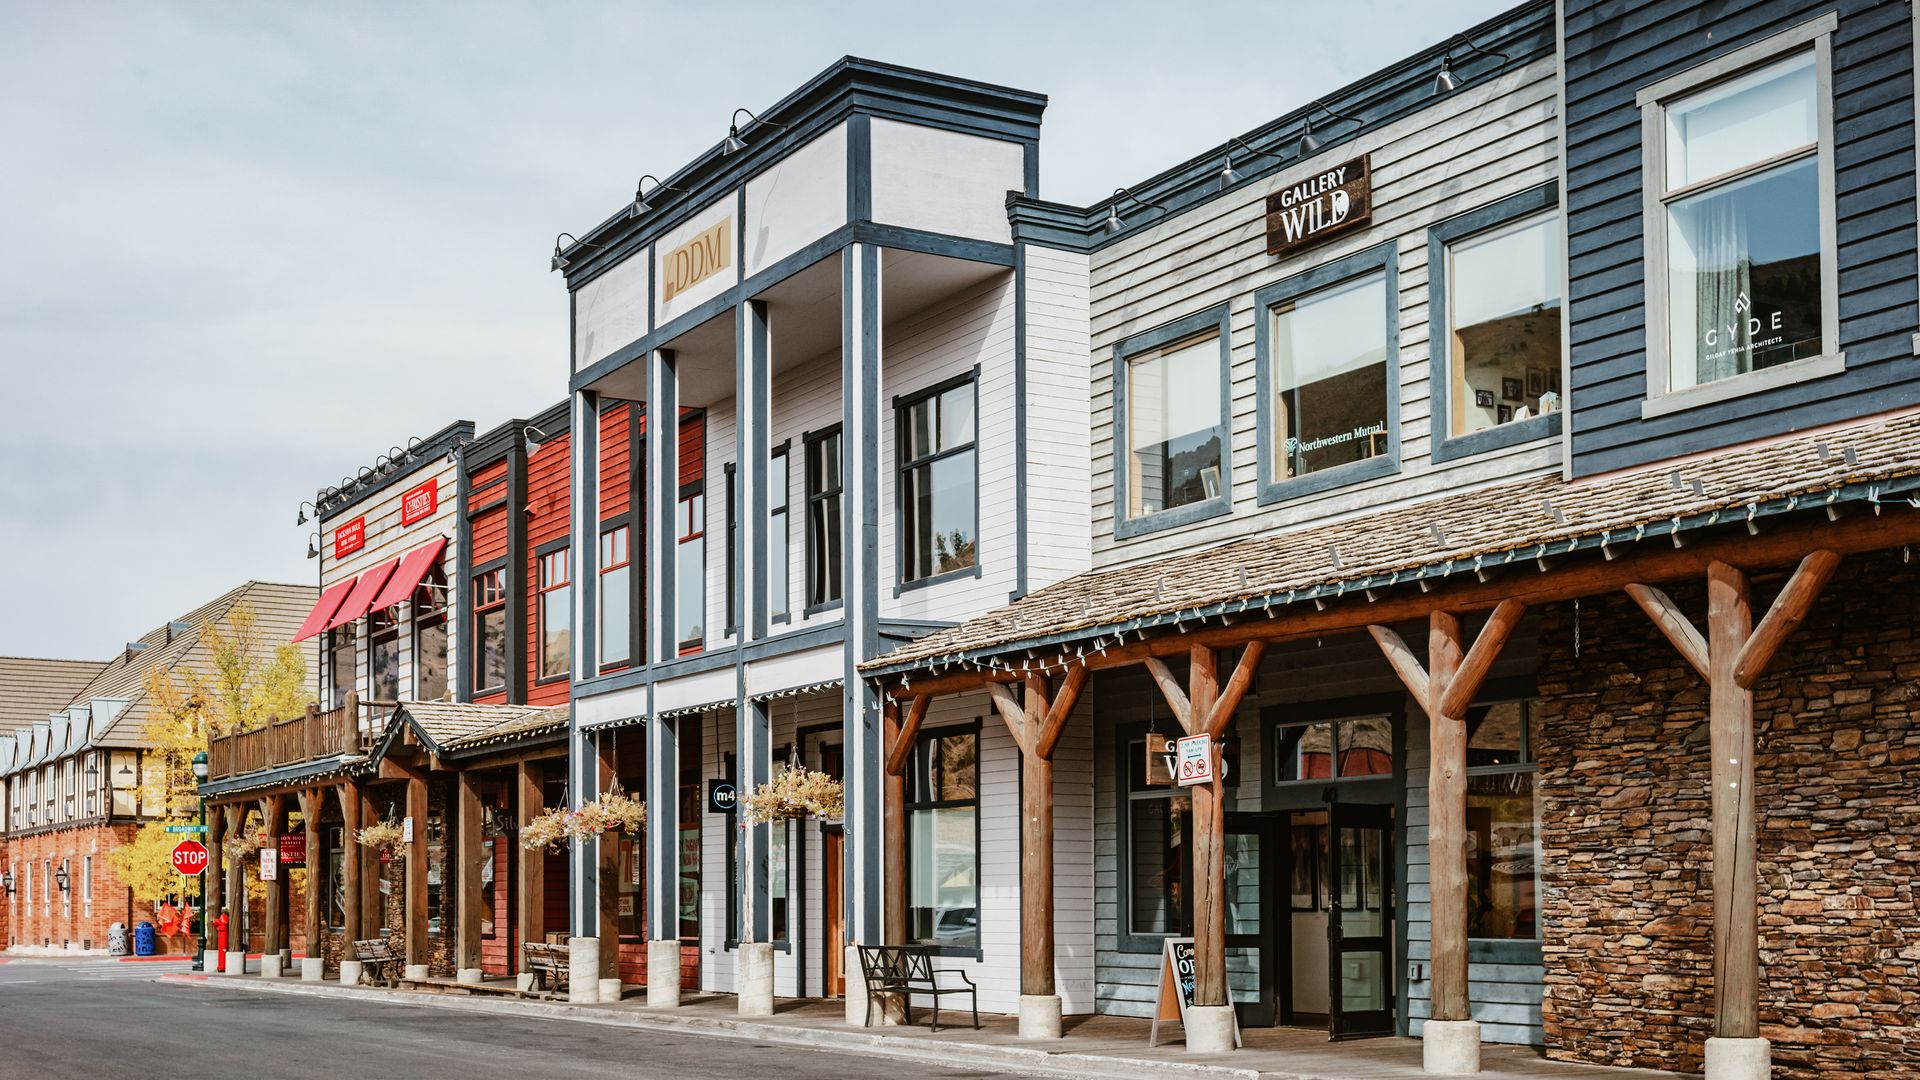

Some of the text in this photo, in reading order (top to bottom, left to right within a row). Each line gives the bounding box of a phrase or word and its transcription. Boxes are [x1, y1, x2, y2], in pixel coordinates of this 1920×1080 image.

[1281, 166, 1347, 208] GALLERY
[1280, 189, 1350, 243] WILD
[675, 226, 723, 293] DDM
[1705, 311, 1782, 346] GYDE
[1746, 336, 1783, 351] ARCHITECTS
[1298, 420, 1384, 453] Northwestern Mutual
[716, 790, 736, 802] m4
[174, 851, 206, 865] STOP
